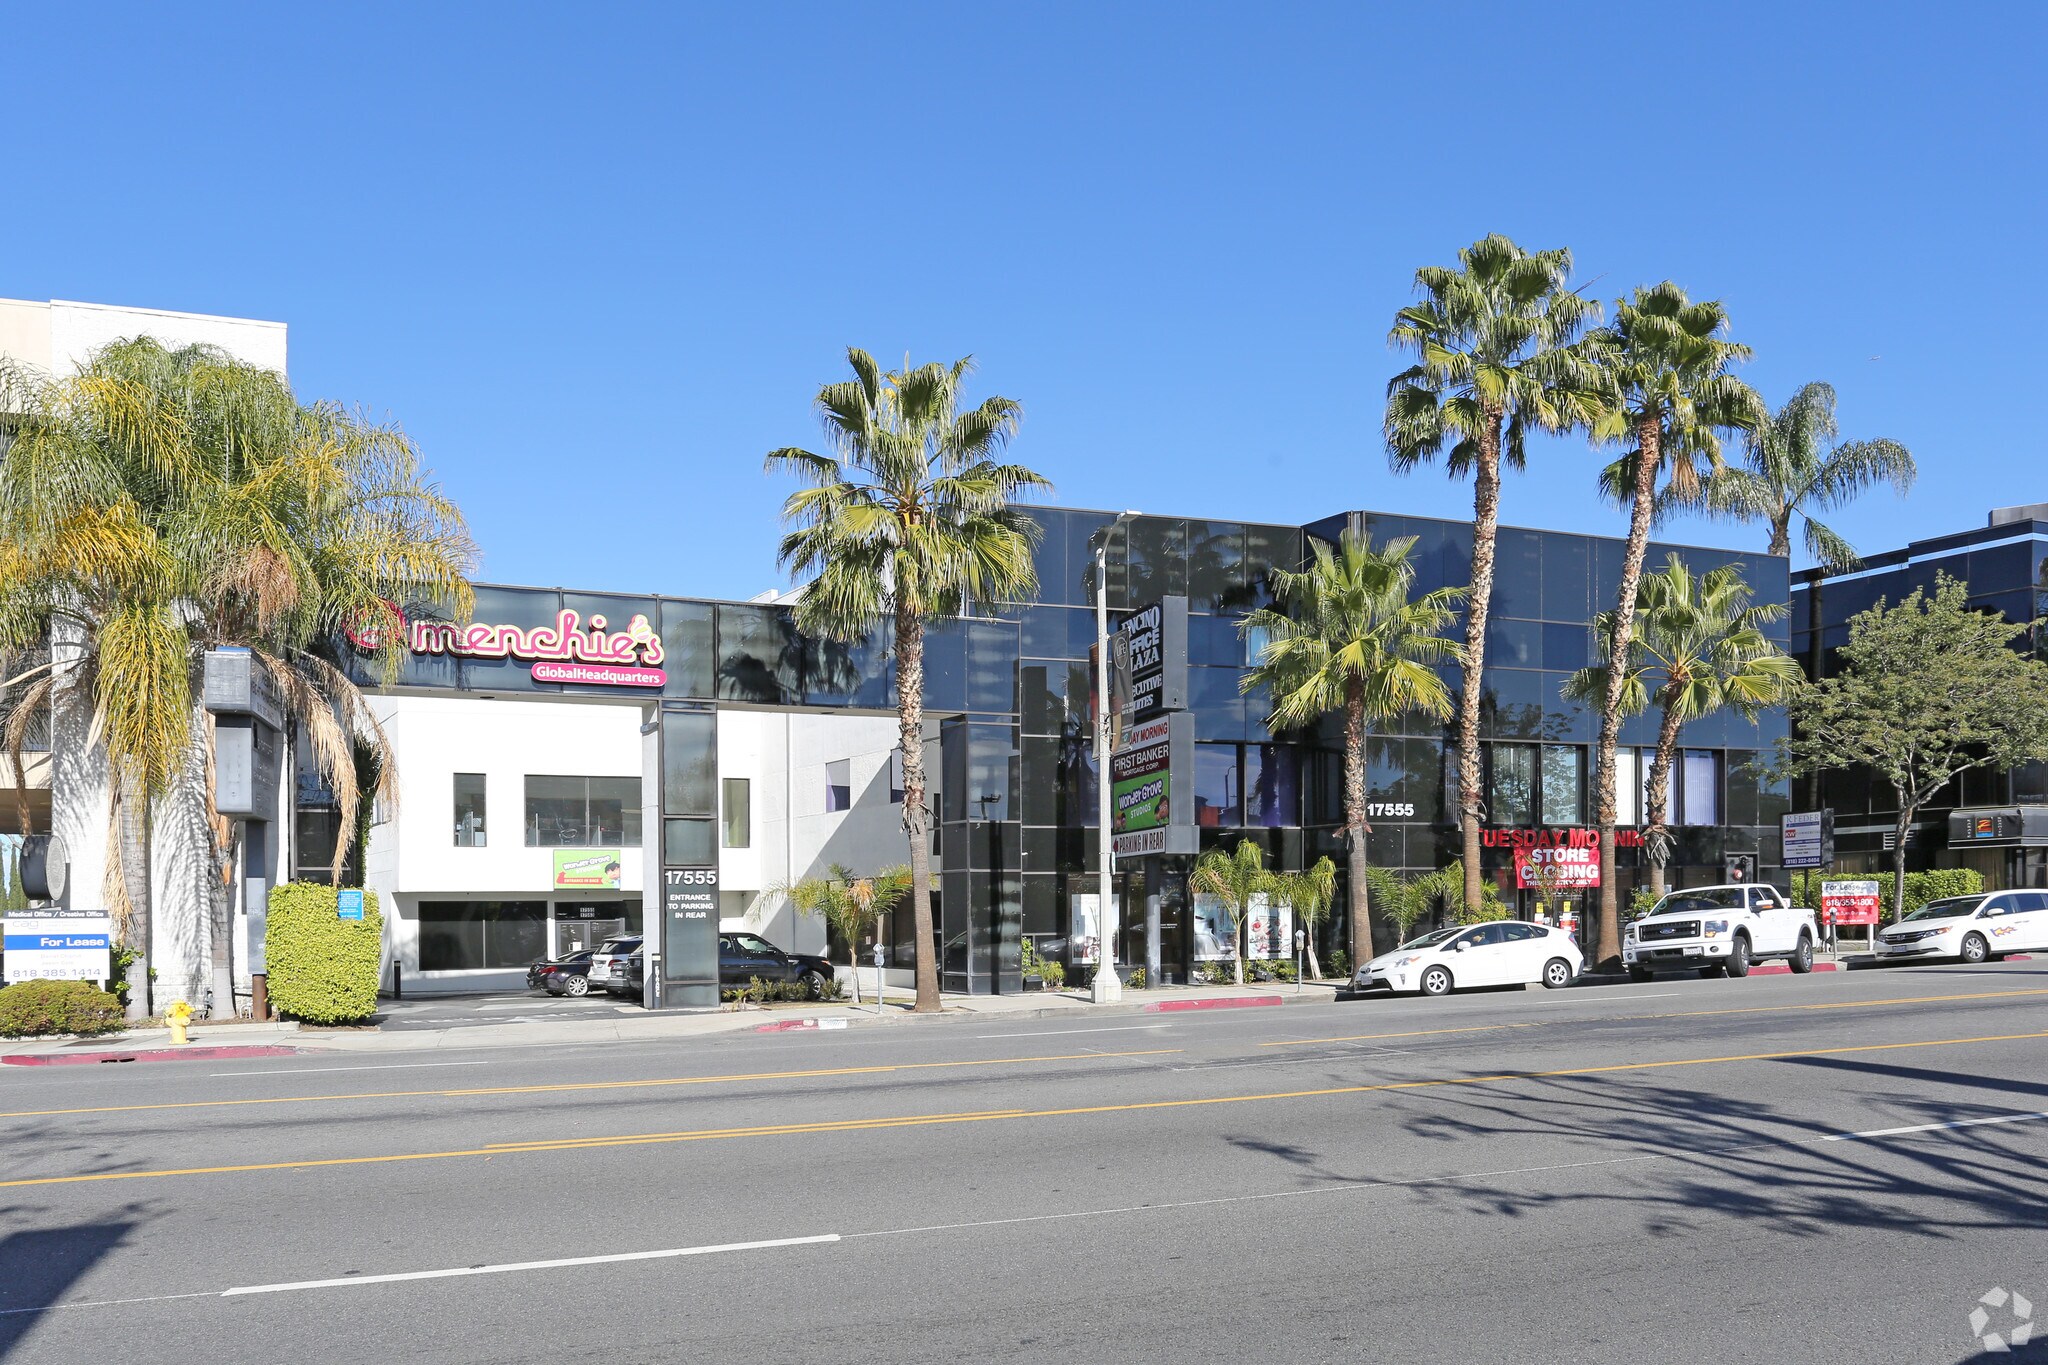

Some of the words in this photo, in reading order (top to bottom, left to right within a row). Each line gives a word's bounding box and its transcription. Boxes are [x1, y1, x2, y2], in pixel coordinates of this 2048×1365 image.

[411, 608, 665, 665] menchie's
[1130, 628, 1160, 655] FFICE
[1131, 646, 1160, 671] LAZA
[536, 665, 660, 684] GlobalHeadquarters
[1140, 722, 1168, 741] MORNING
[1114, 753, 1137, 771] FIRST
[1137, 745, 1168, 764] BANKER
[1123, 765, 1145, 776] MORTGAGE
[1119, 790, 1141, 809] Wonder
[1141, 780, 1163, 800] Grove
[1130, 802, 1152, 819] STUDIOS
[1367, 803, 1414, 817] 17555
[1120, 834, 1141, 854] PARKING
[1142, 833, 1149, 851] IN
[1149, 831, 1164, 851] REAR
[1569, 828, 1645, 847] MONIN
[1532, 848, 1590, 862] STORE
[665, 870, 716, 885] 17555
[41, 937, 63, 947] For
[66, 937, 105, 946] Lease
[13, 969, 37, 978] 818
[43, 969, 66, 977] 385
[72, 968, 101, 976] 1414
